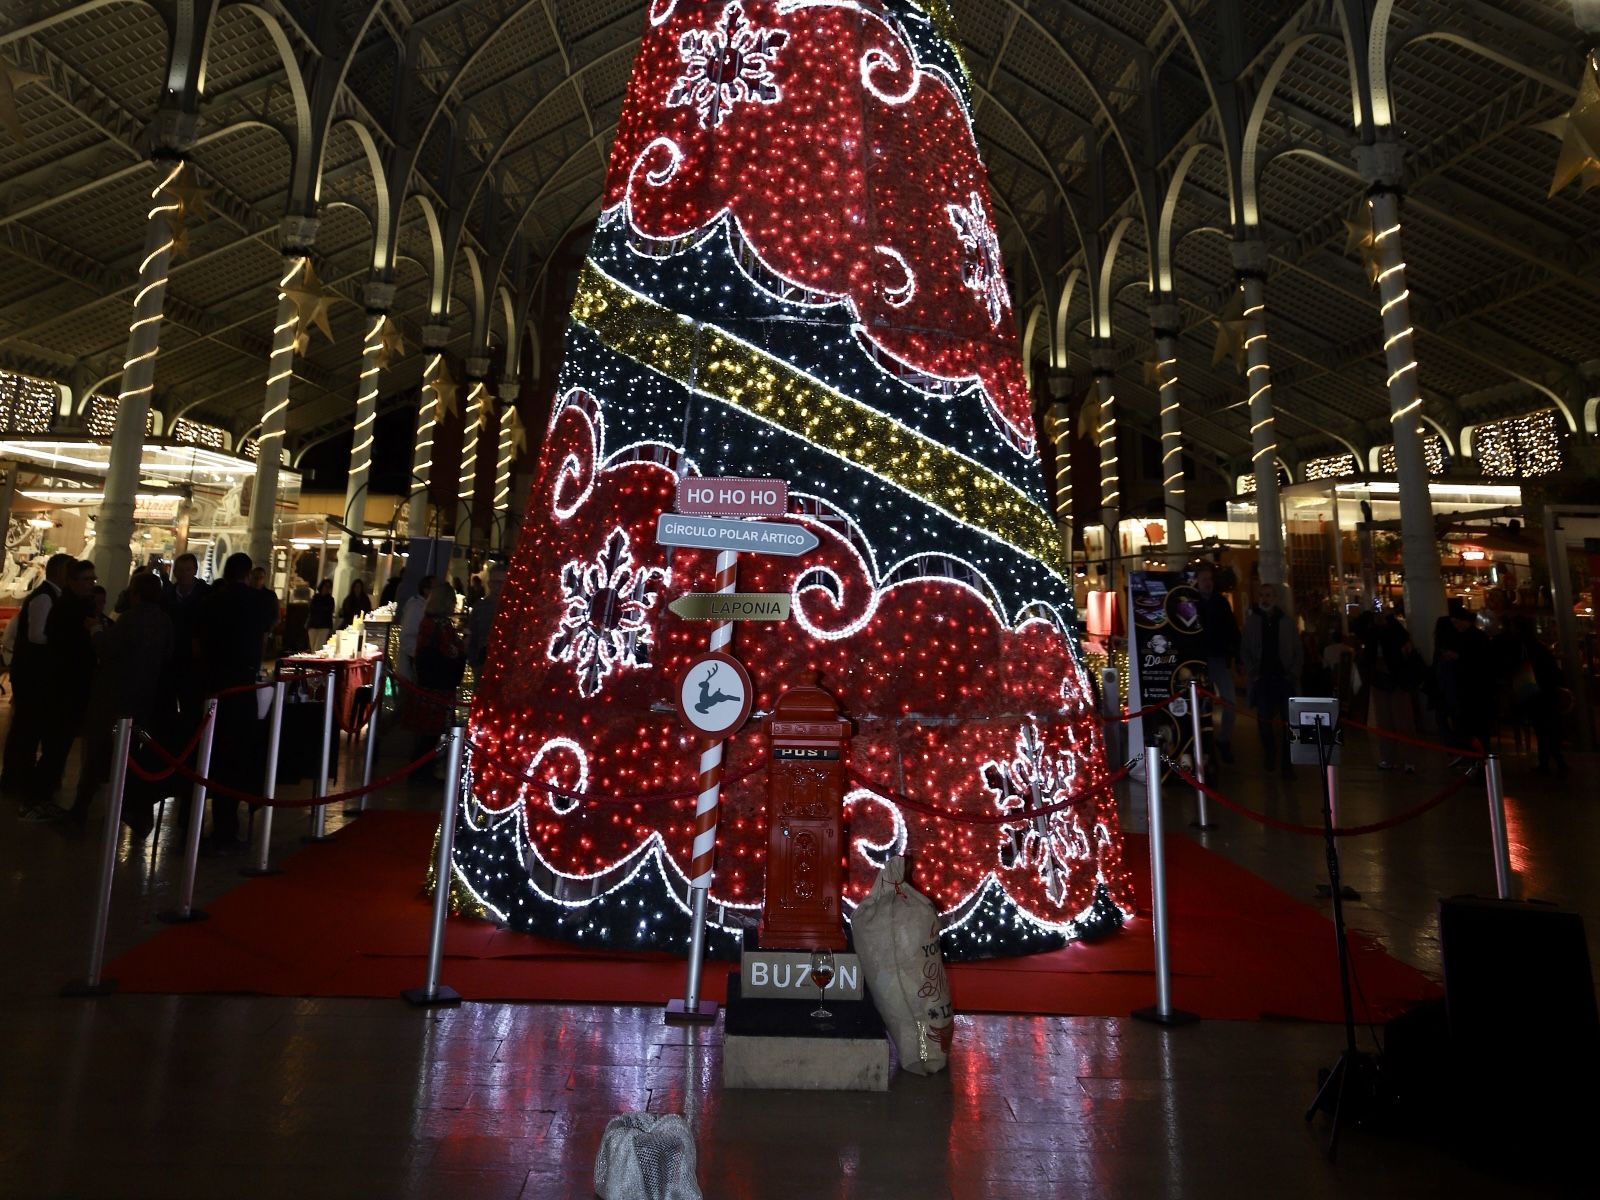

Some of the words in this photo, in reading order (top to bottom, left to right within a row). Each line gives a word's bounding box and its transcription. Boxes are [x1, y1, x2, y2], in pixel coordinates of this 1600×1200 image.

[687, 488, 714, 503] HO
[719, 489, 746, 504] HO
[751, 490, 777, 505] HO
[664, 522, 717, 538] CÍRCULO
[719, 528, 759, 542] POLAR
[761, 530, 805, 545] ÁRTICO
[711, 602, 781, 614] LAPONIA
